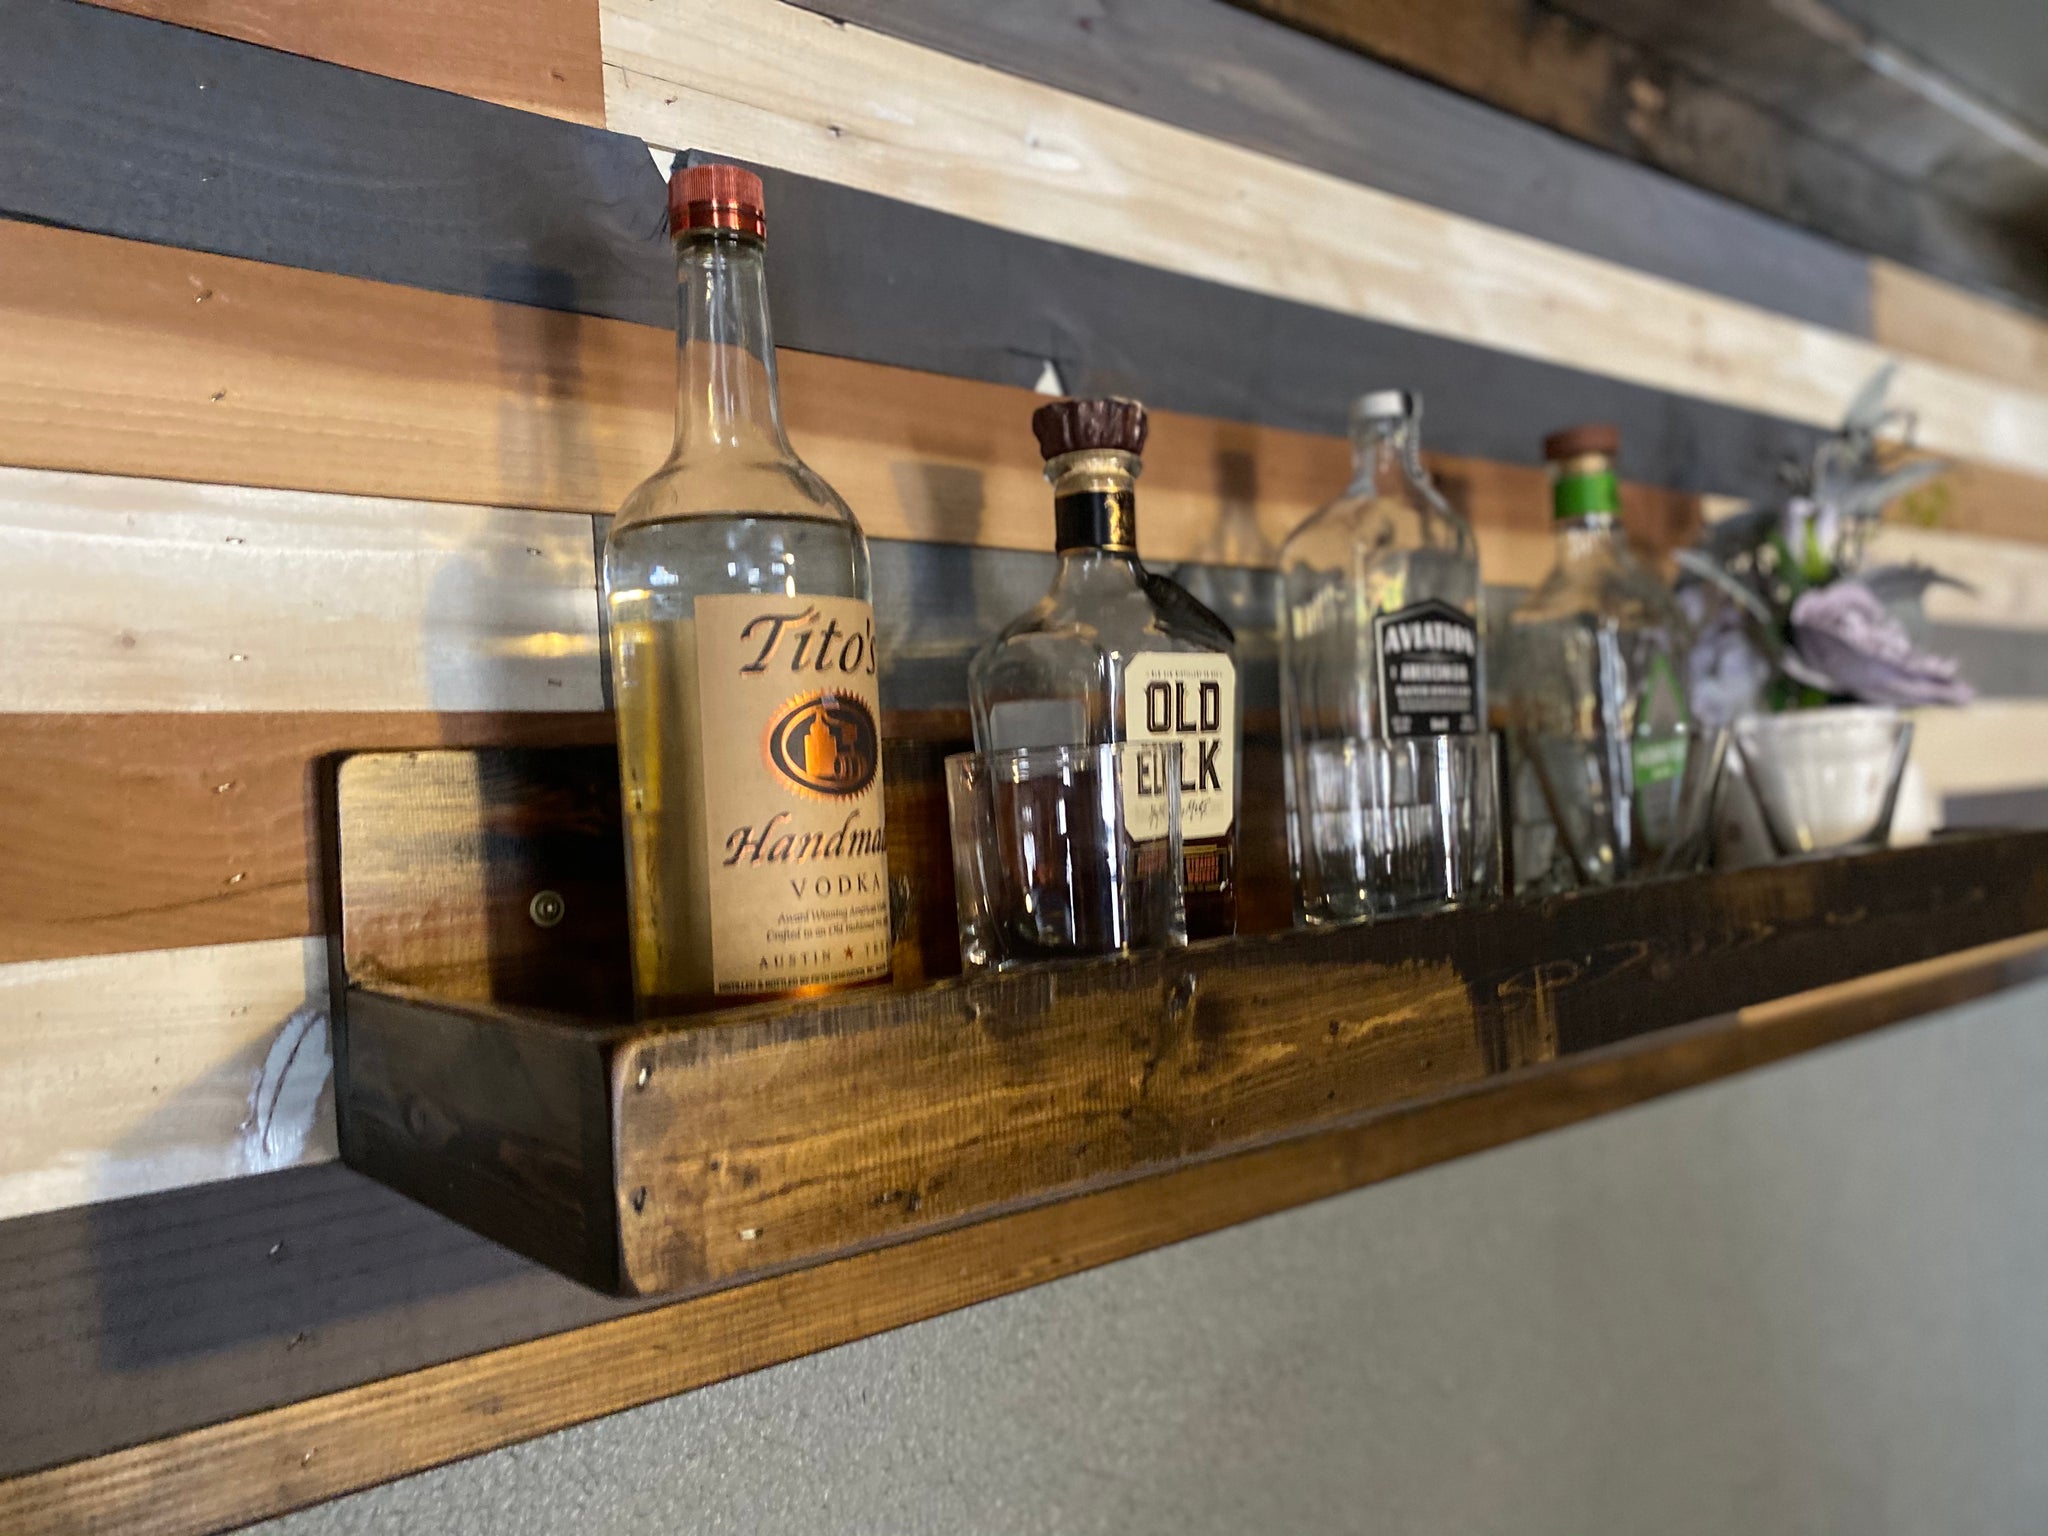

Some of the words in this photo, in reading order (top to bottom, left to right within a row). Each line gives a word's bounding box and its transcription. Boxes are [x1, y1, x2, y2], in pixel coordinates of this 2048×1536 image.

[739, 604, 876, 677] Tito's
[1145, 680, 1220, 733] OLD
[791, 871, 881, 900] VODKA
[778, 907, 808, 925] Award
[766, 926, 800, 943] Crafted
[759, 950, 831, 970] AUSTIN
